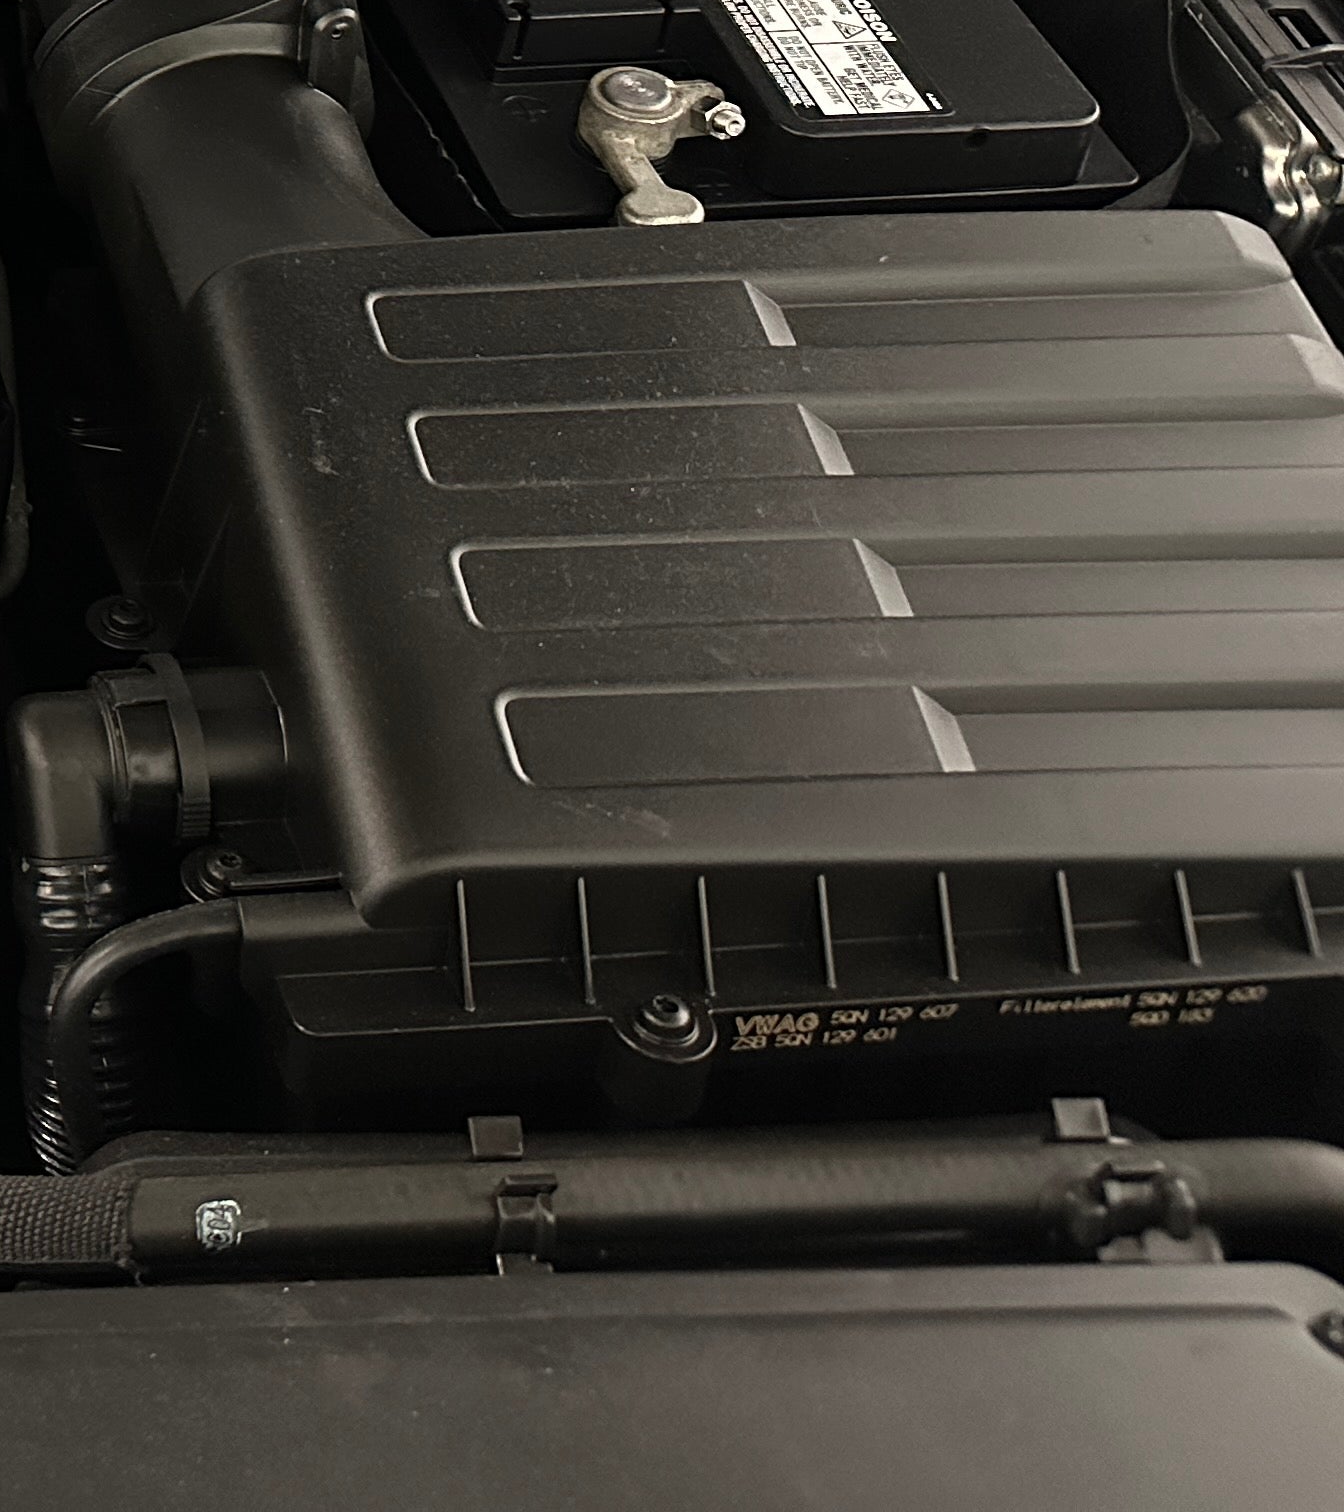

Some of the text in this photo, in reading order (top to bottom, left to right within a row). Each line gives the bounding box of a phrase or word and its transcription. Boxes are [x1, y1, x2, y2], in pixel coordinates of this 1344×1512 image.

[783, 46, 801, 58] NOT
[794, 45, 813, 58] NOT
[841, 44, 864, 61] WITH
[803, 59, 826, 76] OPEN
[853, 43, 897, 87] IMMEDIATELY
[866, 43, 905, 81] FLUSH EYES
[835, 75, 858, 91] HELP
[842, 67, 885, 110] GET MEDICAL
[878, 1006, 913, 1022] 129
[919, 1003, 960, 1020] 607
[822, 1029, 857, 1044] 129
[863, 1026, 898, 1042] 601
